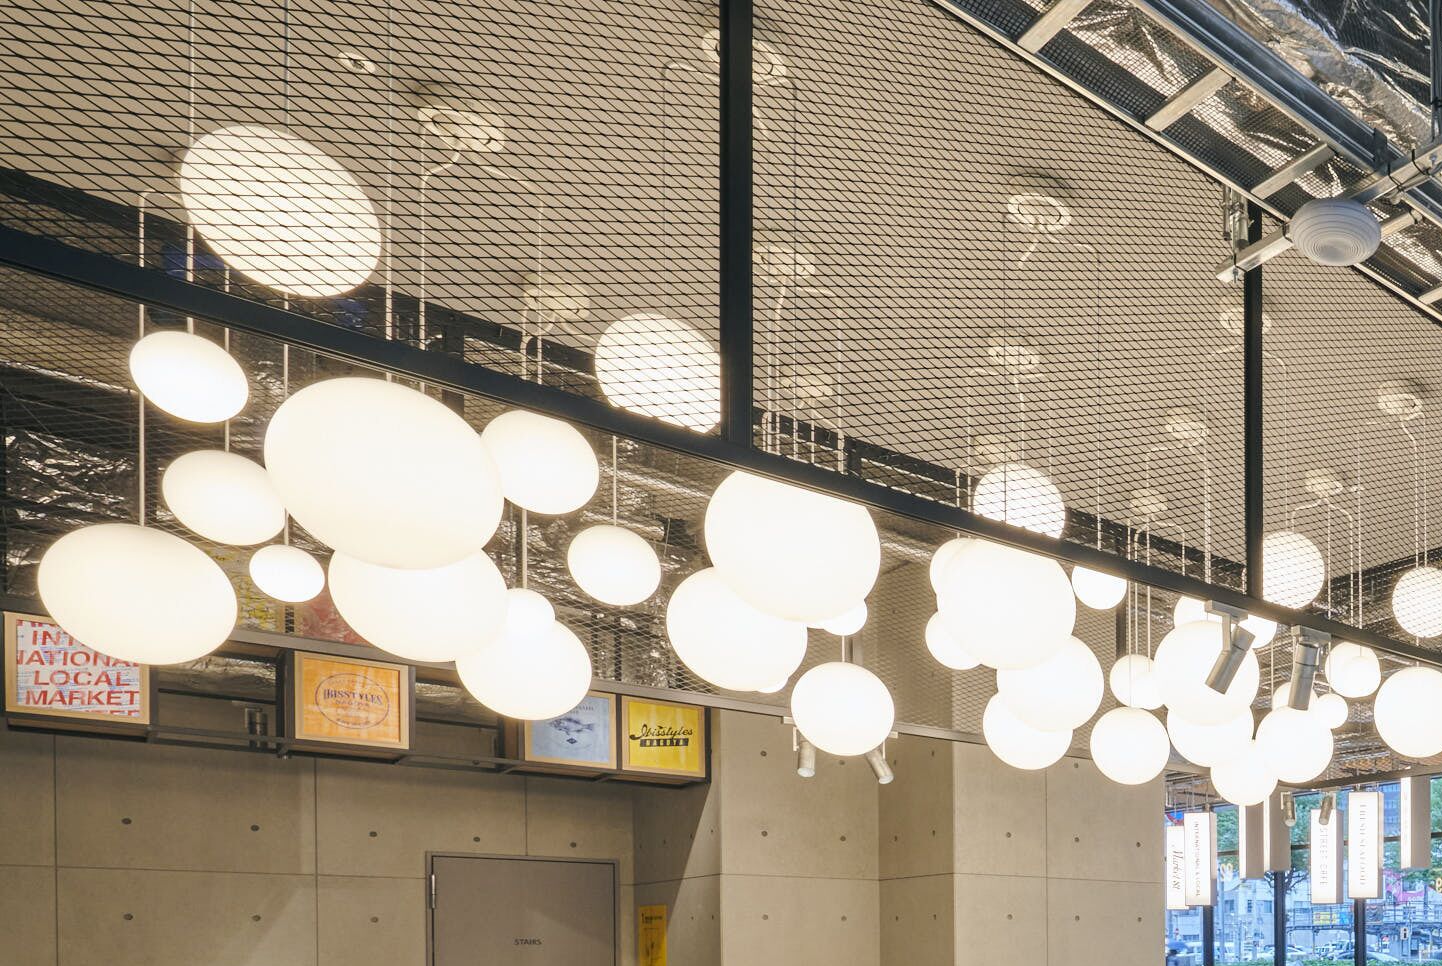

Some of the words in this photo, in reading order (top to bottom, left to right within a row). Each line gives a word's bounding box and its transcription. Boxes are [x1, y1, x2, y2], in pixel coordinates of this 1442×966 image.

[33, 670, 131, 687] LOCAL
[25, 689, 140, 706] MARKET
[1319, 827, 1329, 860] STREET
[1319, 863, 1329, 886] CAFE
[513, 938, 543, 946] STAIRS
